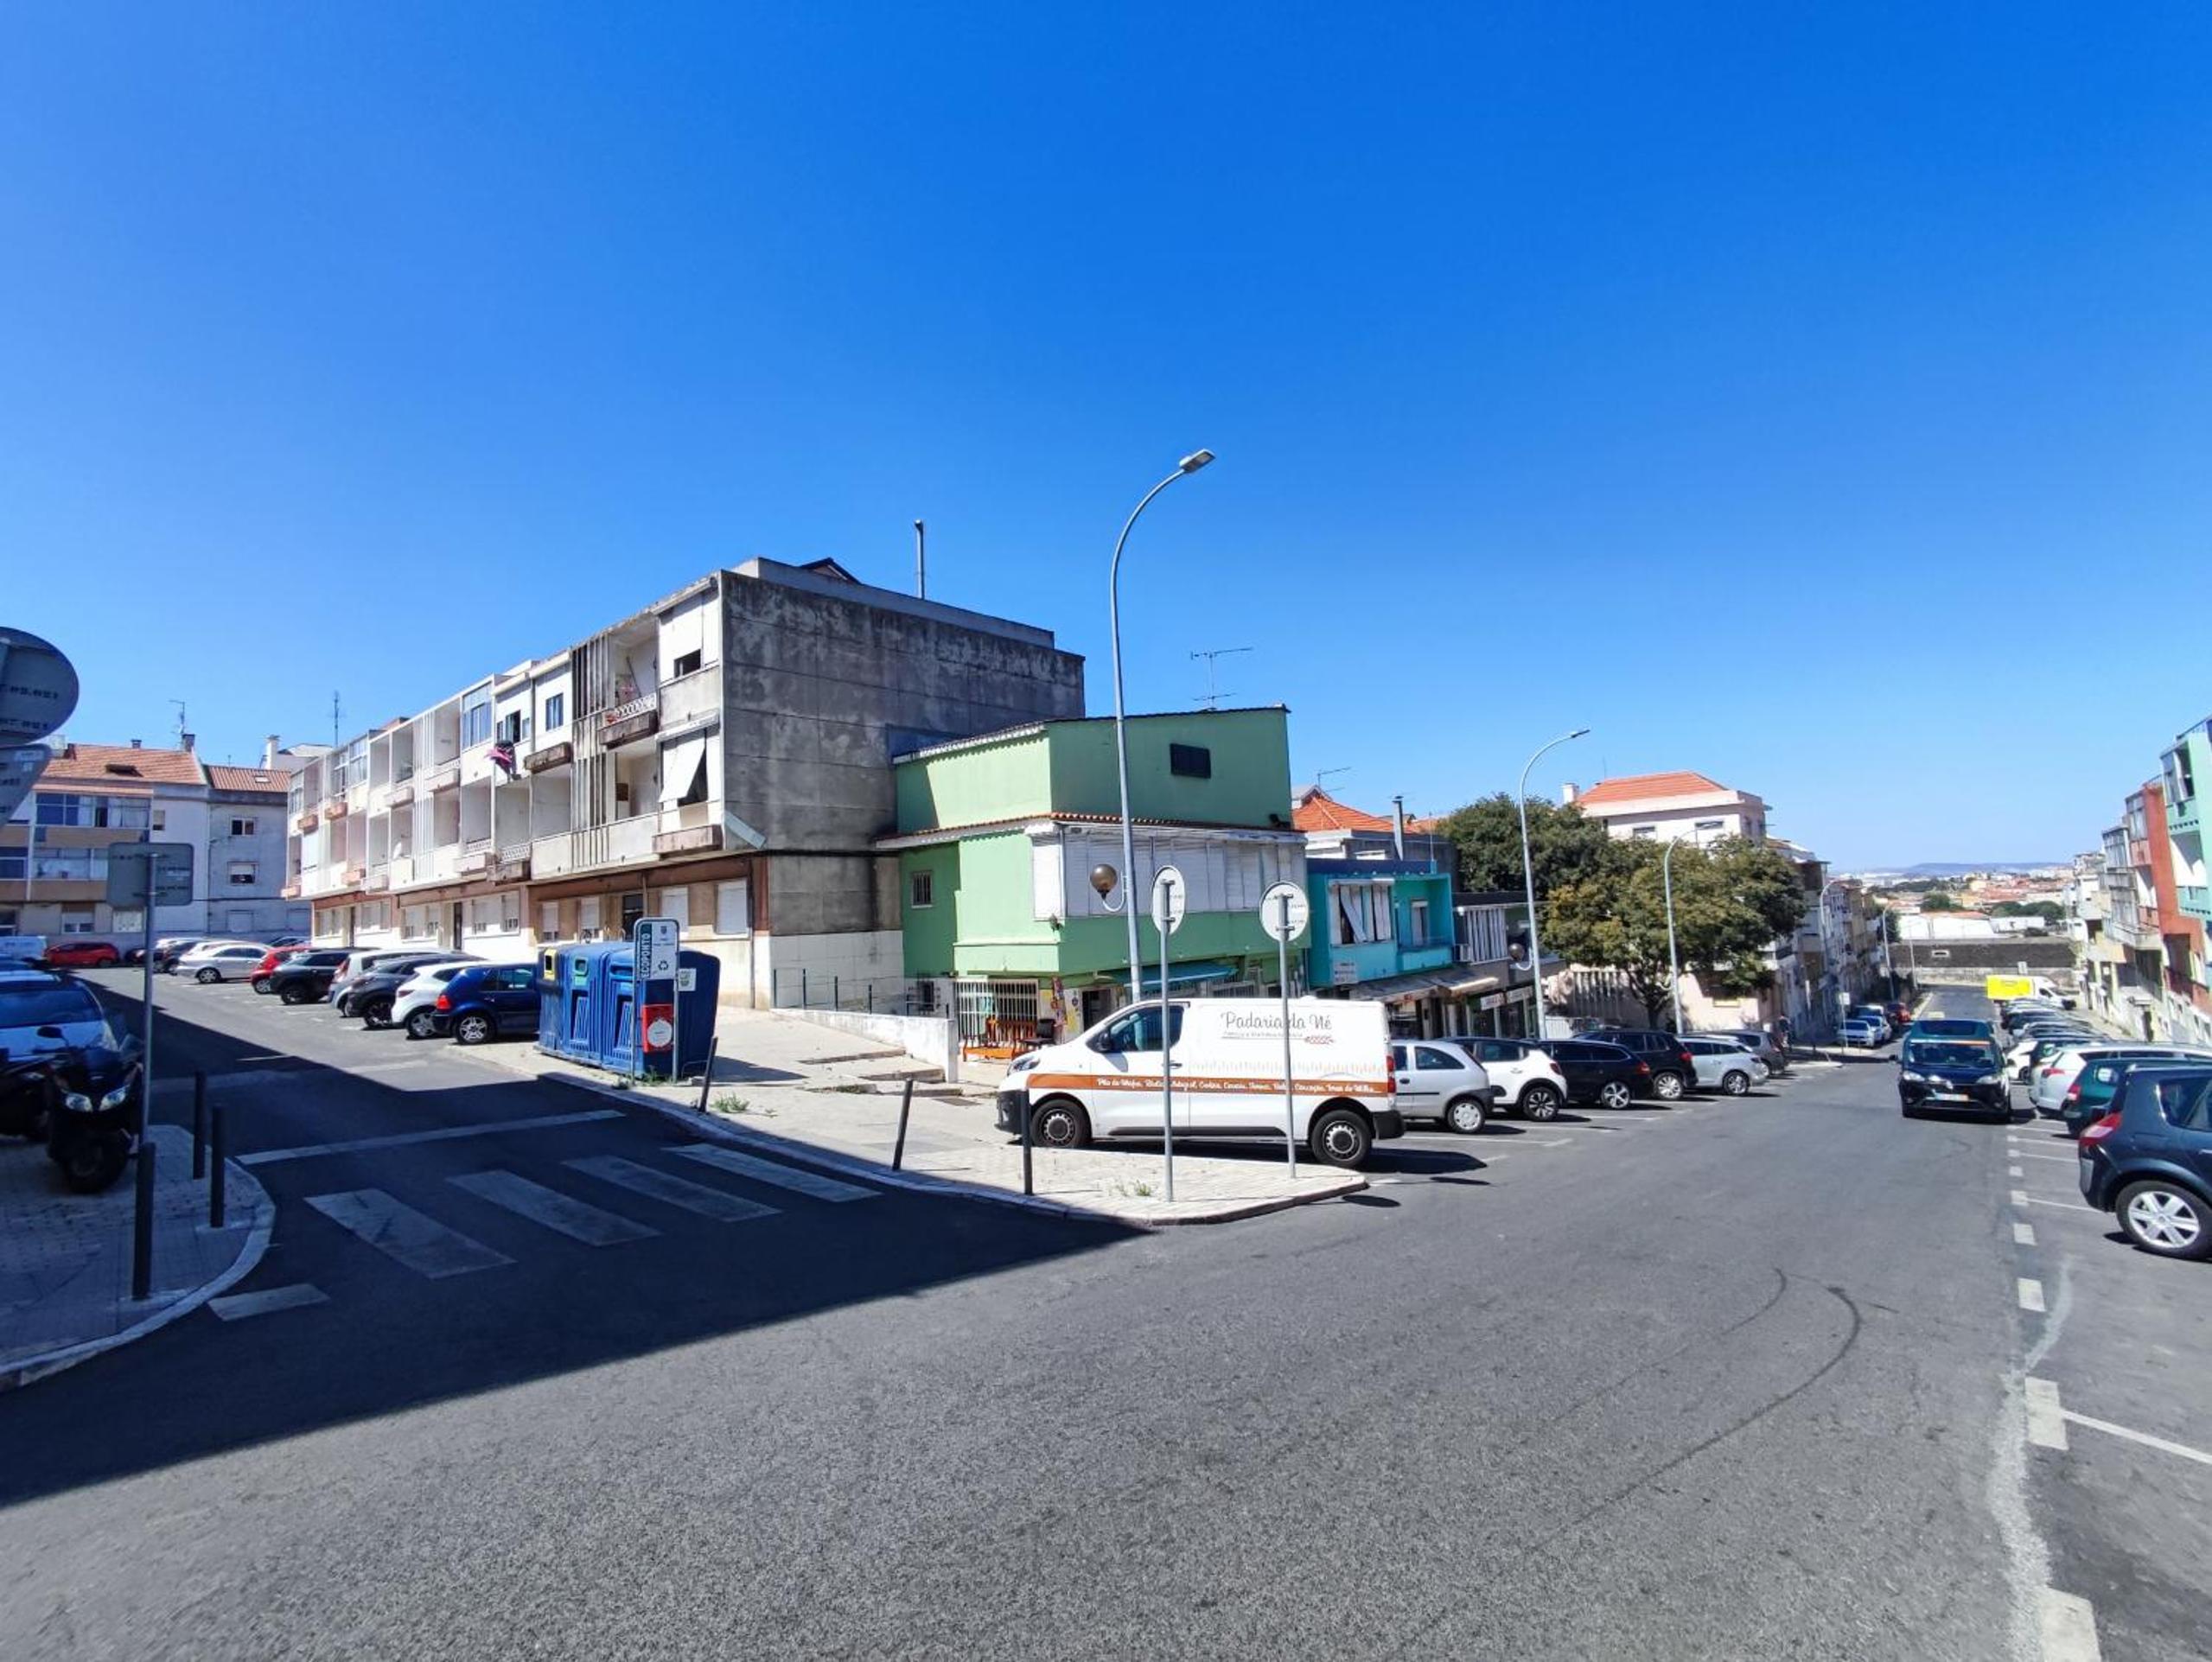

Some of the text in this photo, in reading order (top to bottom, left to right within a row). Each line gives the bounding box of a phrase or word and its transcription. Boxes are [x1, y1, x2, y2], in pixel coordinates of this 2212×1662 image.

[641, 933, 651, 978] ECOPONTO
[1220, 1010, 1284, 1029] Padaria
[1309, 1013, 1333, 1030] Né
